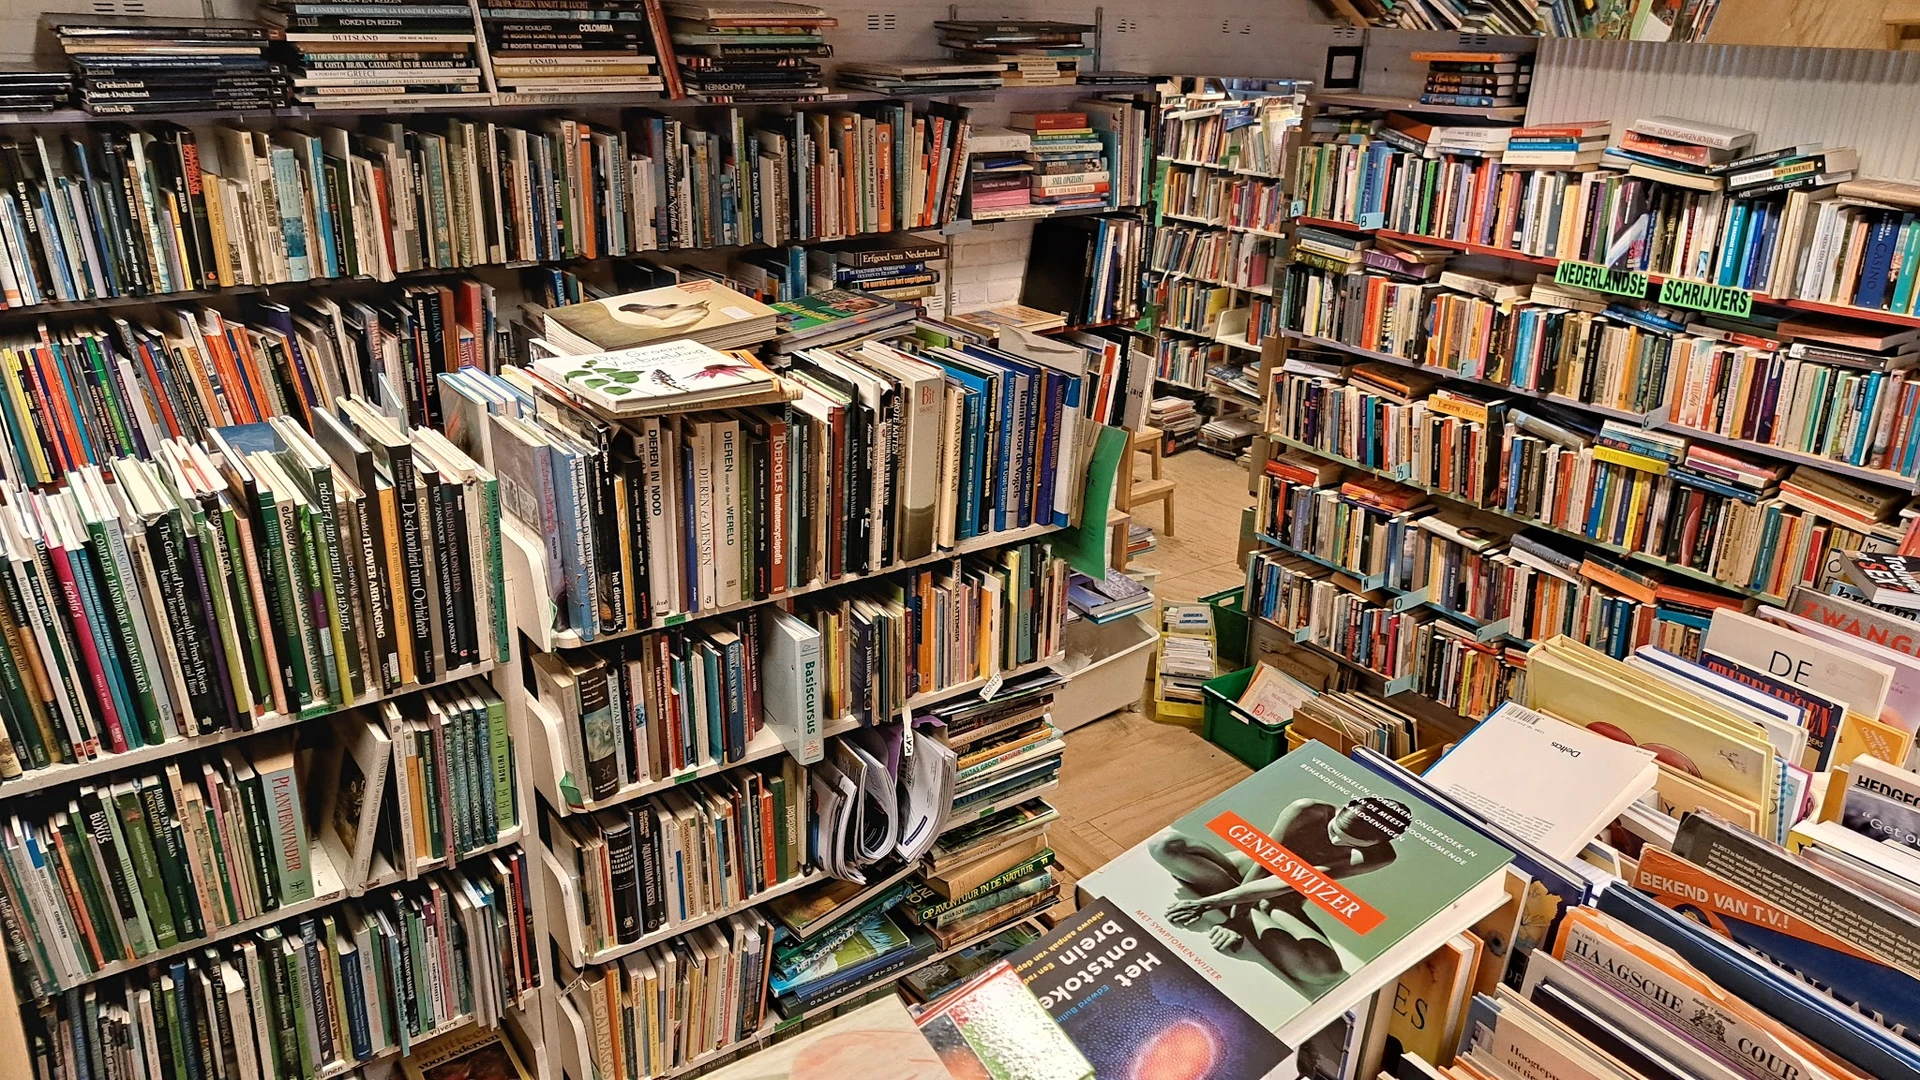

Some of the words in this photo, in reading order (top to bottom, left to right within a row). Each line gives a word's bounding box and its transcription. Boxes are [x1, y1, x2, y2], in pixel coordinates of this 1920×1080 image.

[578, 24, 614, 33] COLOMBIA
[324, 61, 345, 69] COSTA
[403, 61, 412, 69] EN
[421, 61, 454, 69] BALEAREN
[96, 80, 145, 89] Griekenland
[96, 104, 135, 114] Frankrijk
[867, 127, 875, 156] Nederland
[1766, 184, 1780, 192] HUGO
[1292, 203, 1299, 215] A
[1360, 215, 1367, 227] B
[863, 252, 890, 264] Erfgoed
[905, 248, 940, 259] Nederland
[1866, 243, 1887, 290] CASINO
[1559, 263, 1647, 295] NEDERLANDSE
[1663, 280, 1750, 314] SCHRIJVERS
[370, 319, 381, 360] HIMALAYA
[922, 385, 935, 405] Bit
[1018, 389, 1028, 426] Ruimte
[648, 429, 658, 467] DIEREN
[723, 430, 734, 472] DIEREN
[1016, 428, 1026, 447] voor
[650, 470, 660, 481] IN
[773, 434, 787, 492] TOEPOELS
[699, 468, 710, 507] DIEREN
[951, 475, 959, 493] KAT
[1013, 464, 1024, 499] Vogels
[358, 502, 368, 513] The
[400, 502, 416, 514] De
[650, 485, 661, 517] NOOD
[159, 523, 171, 540] The
[360, 513, 370, 531] World
[726, 506, 735, 546] WERELD
[164, 541, 178, 574] Gardens
[307, 541, 317, 571] nieuwe
[362, 537, 377, 579] FLOWER
[401, 515, 420, 566] schoonheid
[701, 521, 711, 566] MENSEN
[110, 529, 137, 601] BLOEMSCHIKKEN
[221, 551, 233, 577] FLORA
[411, 568, 422, 586] van
[610, 571, 621, 583] het
[62, 581, 83, 618] Fuchsia's
[93, 533, 115, 577] COMPLEET
[106, 579, 129, 625] HANDBOEK
[118, 626, 149, 694] BLOEMSCHIKKEN
[173, 581, 189, 616] Provence
[368, 580, 386, 639] ARRANGING
[610, 583, 624, 626] dierenrijk
[182, 616, 192, 628] and
[184, 628, 195, 640] the
[1799, 600, 1920, 658] ZWANG
[187, 641, 201, 665] French
[1768, 650, 1813, 687] DE
[194, 667, 208, 694] Riviera
[804, 661, 818, 735] Basiscursus
[905, 735, 913, 754] KAT
[1550, 741, 1581, 759] Deltas
[271, 775, 302, 873] PLANTENVINDER
[785, 805, 799, 846] papegaaien
[1300, 763, 1351, 796] BEHANDELING
[1350, 793, 1368, 806] VAN
[1367, 802, 1379, 813] DE
[1378, 809, 1405, 828] MEEST
[1404, 825, 1468, 867] VOORKOMENDE
[1311, 757, 1370, 797] VERSCHIJNSELEN,
[1371, 792, 1413, 821] OORZAKEN,
[1413, 819, 1464, 851] ONDERZOEK
[1463, 846, 1478, 858] EN
[1342, 803, 1405, 843] AANDOENINGEN
[89, 811, 109, 844] BUXUS
[1227, 822, 1364, 921] GENEESWIJZER
[922, 908, 935, 920] OP
[935, 888, 978, 917] AVONTUUR
[979, 885, 989, 898] IN
[990, 880, 1001, 893] DE
[1001, 864, 1034, 888] NATUUR
[1640, 870, 1709, 905] BEKEND
[1713, 891, 1750, 917] VAN
[1751, 903, 1789, 930] T.V.!
[1058, 920, 1124, 966] brein
[1134, 909, 1152, 924] MET
[1149, 921, 1195, 960] SYMPTOMEN
[1194, 956, 1223, 982] WIJZER
[1038, 936, 1138, 1010] ontstoke
[1114, 951, 1162, 987] Het
[1077, 983, 1110, 1009] Edward
[1574, 939, 1684, 1015] HAAGSCHE
[1737, 1036, 1800, 1080] COUR
[594, 1005, 616, 1079] GALAPAGOS
[1509, 1043, 1560, 1080] Hoogtepu
